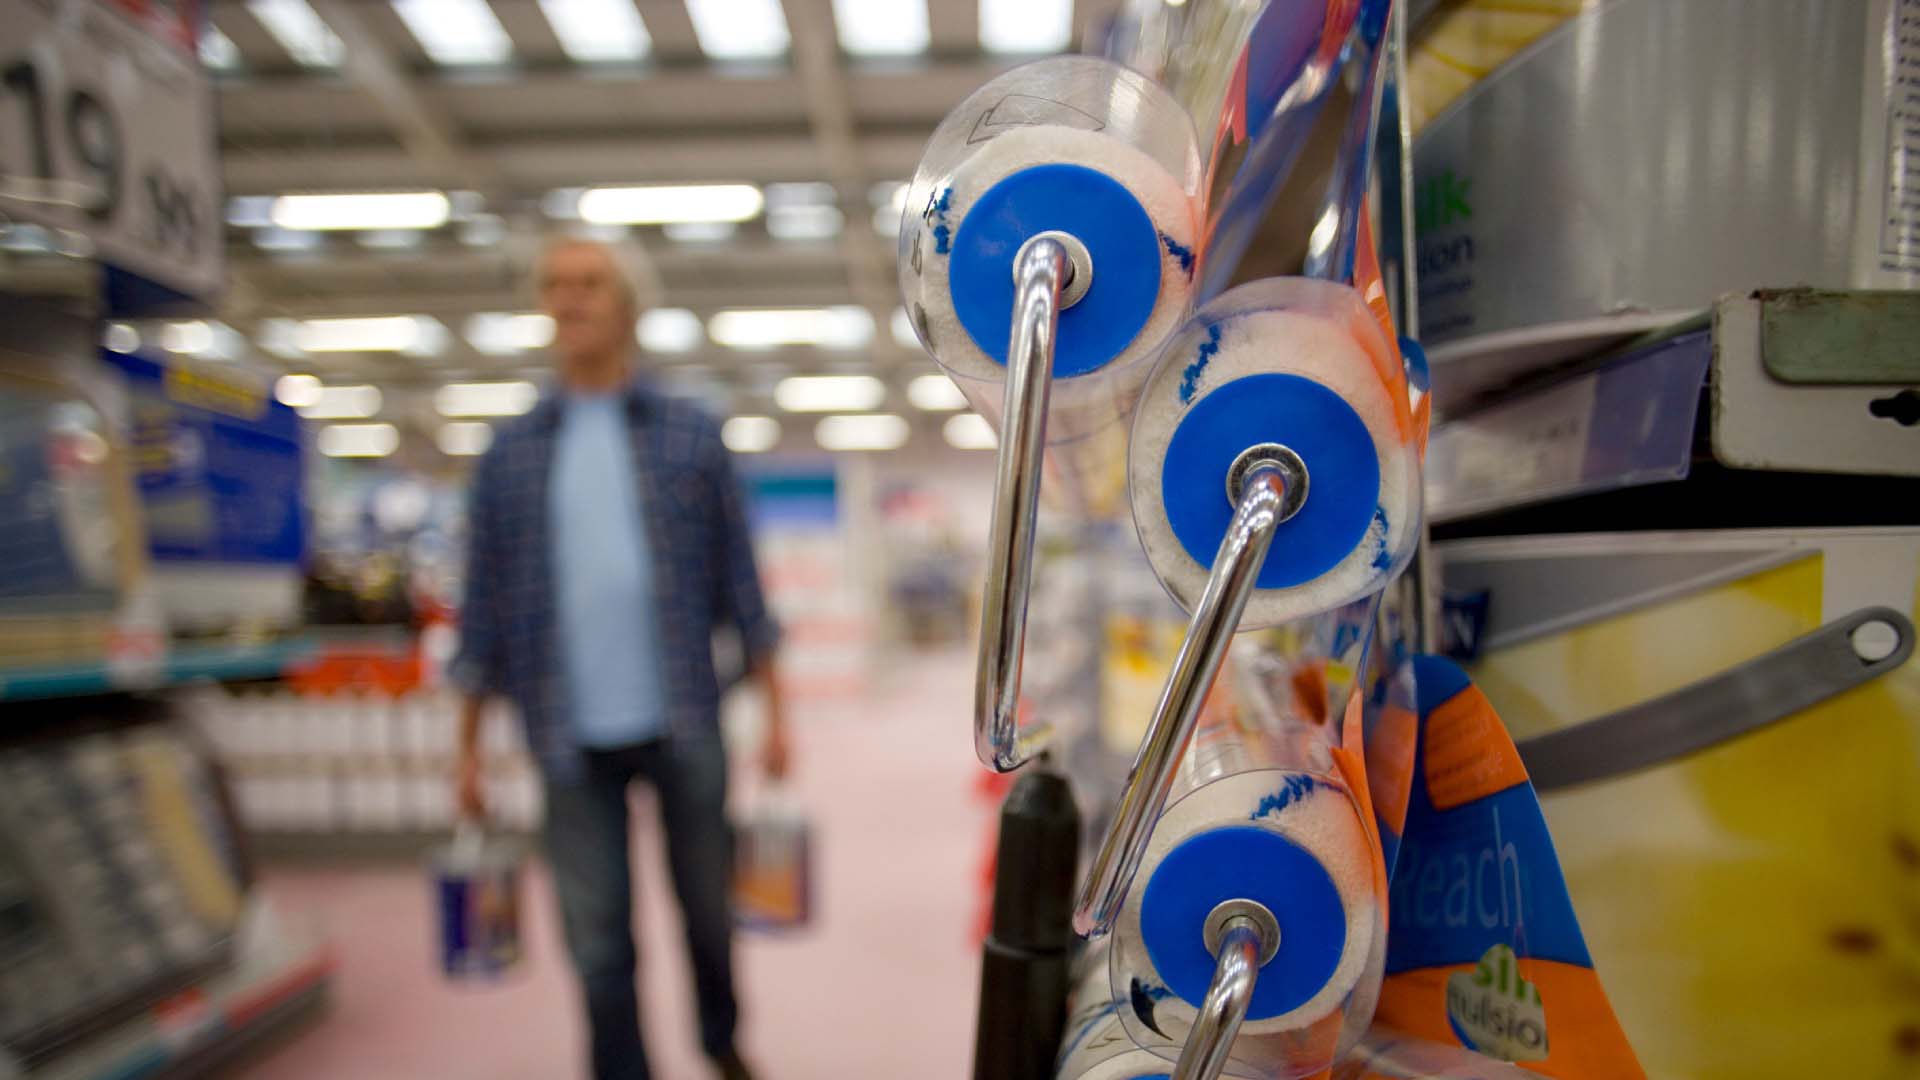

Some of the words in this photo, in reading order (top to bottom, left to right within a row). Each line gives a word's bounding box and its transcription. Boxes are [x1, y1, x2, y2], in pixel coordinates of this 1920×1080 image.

[2, 56, 124, 224] 19
[1416, 166, 1473, 238] ilk
[1416, 234, 1474, 280] ion
[1447, 984, 1550, 1056] ulsio
